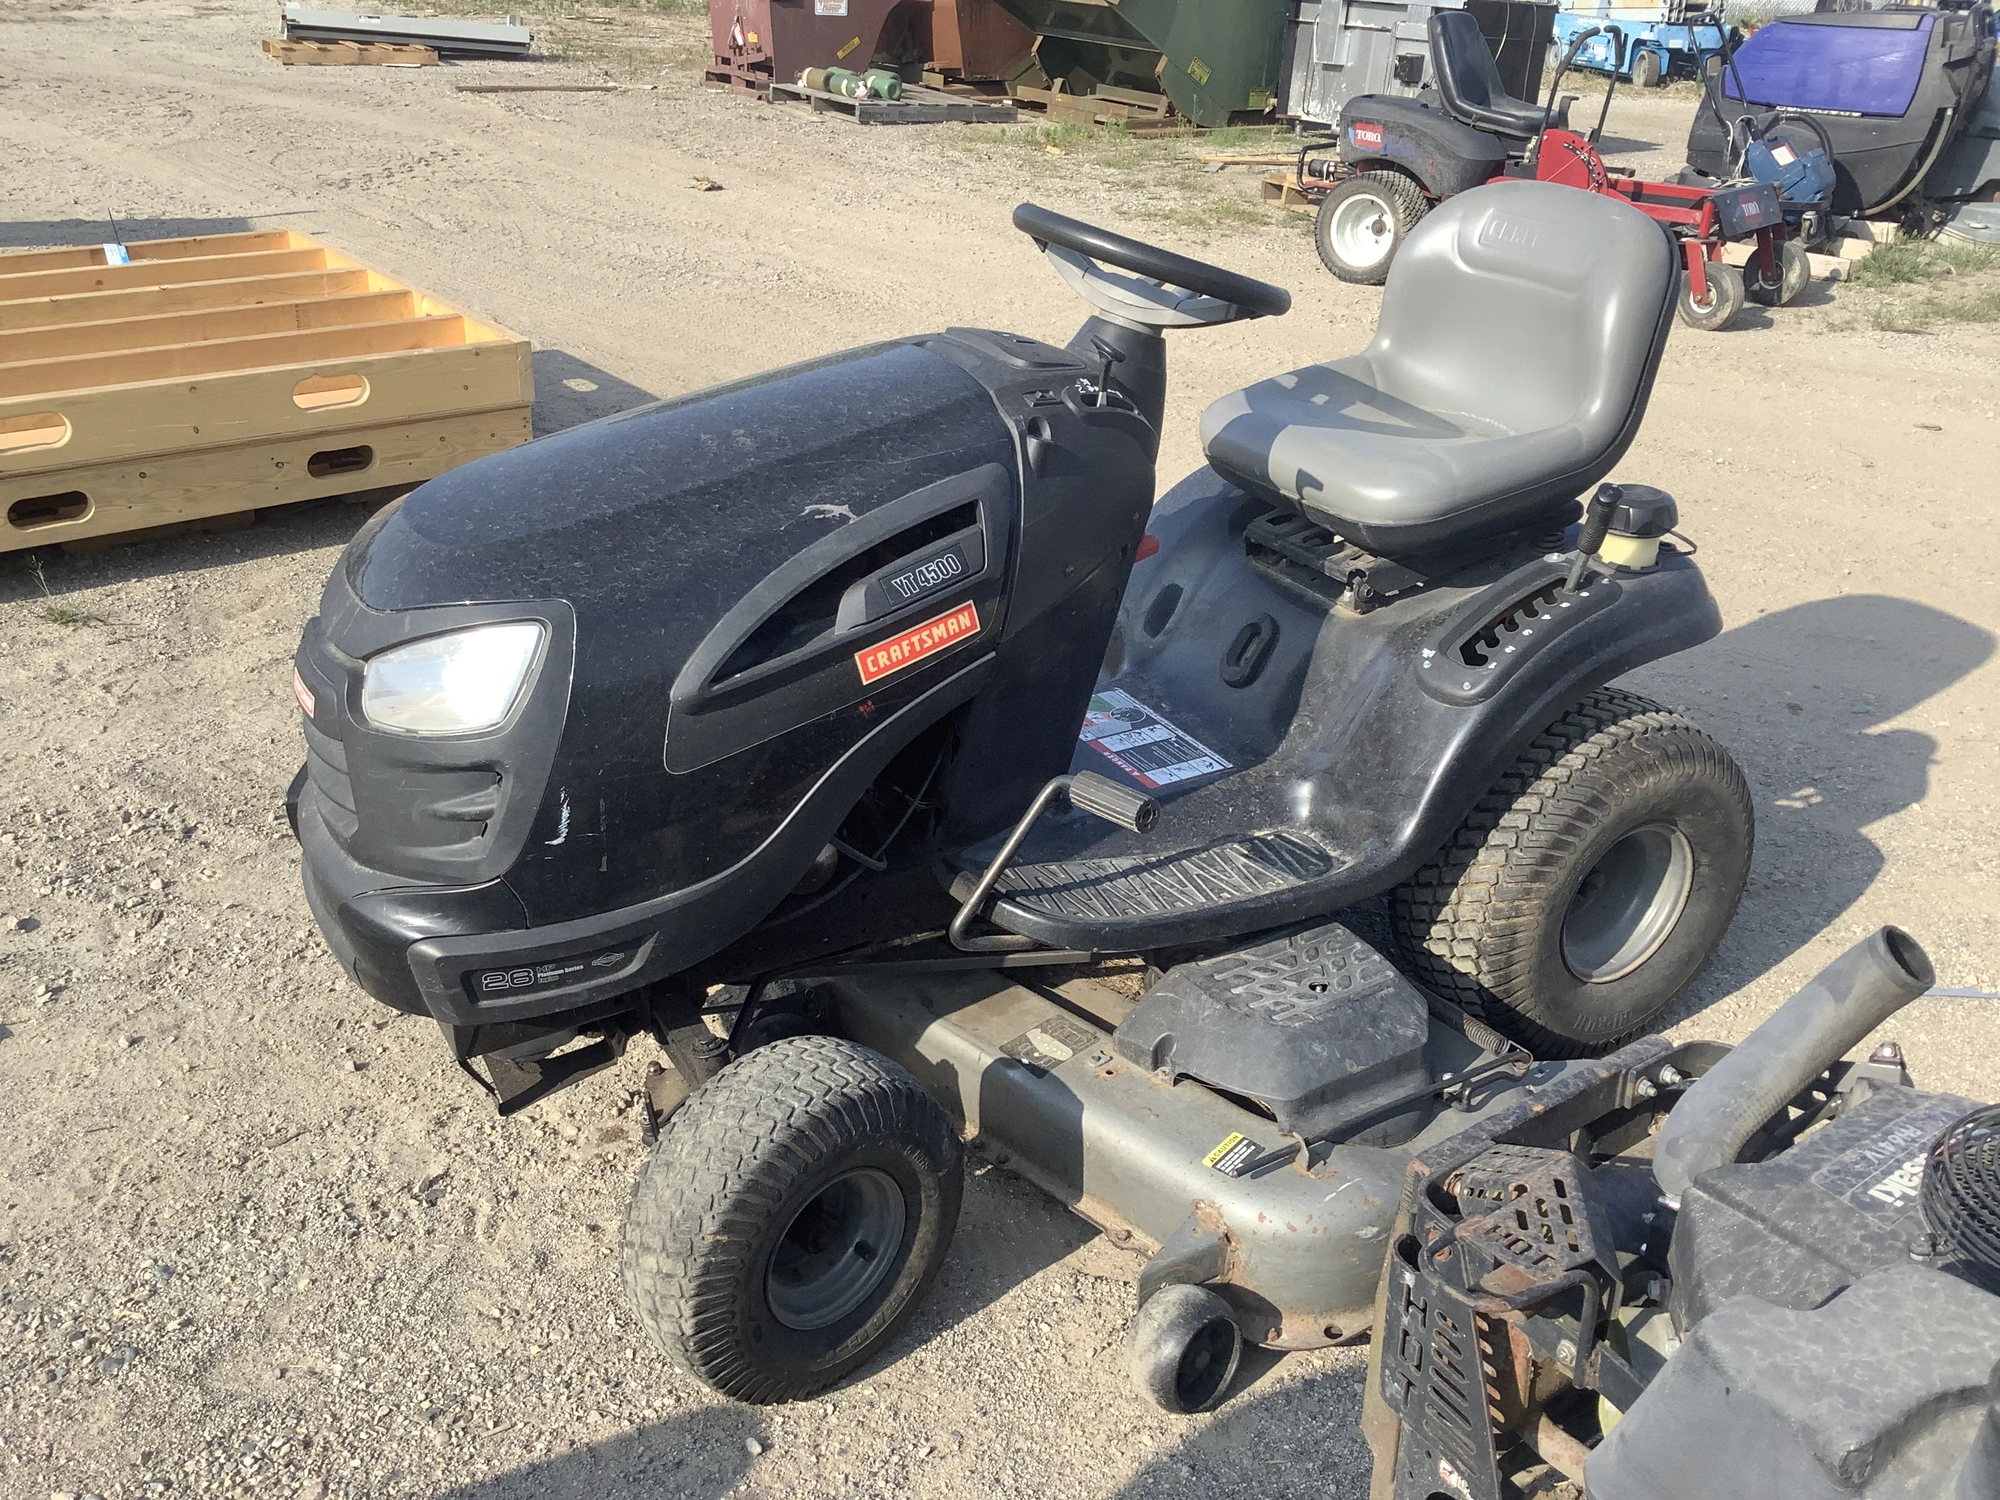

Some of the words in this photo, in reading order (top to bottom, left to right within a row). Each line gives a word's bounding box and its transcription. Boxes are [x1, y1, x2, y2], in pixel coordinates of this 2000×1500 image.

[1356, 129, 1382, 143] TORO
[1741, 201, 1760, 216] TORO
[891, 573, 919, 597] YT
[916, 553, 962, 587] 4500
[866, 611, 972, 673] CRAFTSMAN
[564, 964, 584, 973] Series
[1213, 1135, 1239, 1157] CAUTION
[1396, 1279, 1428, 1411] HOT
